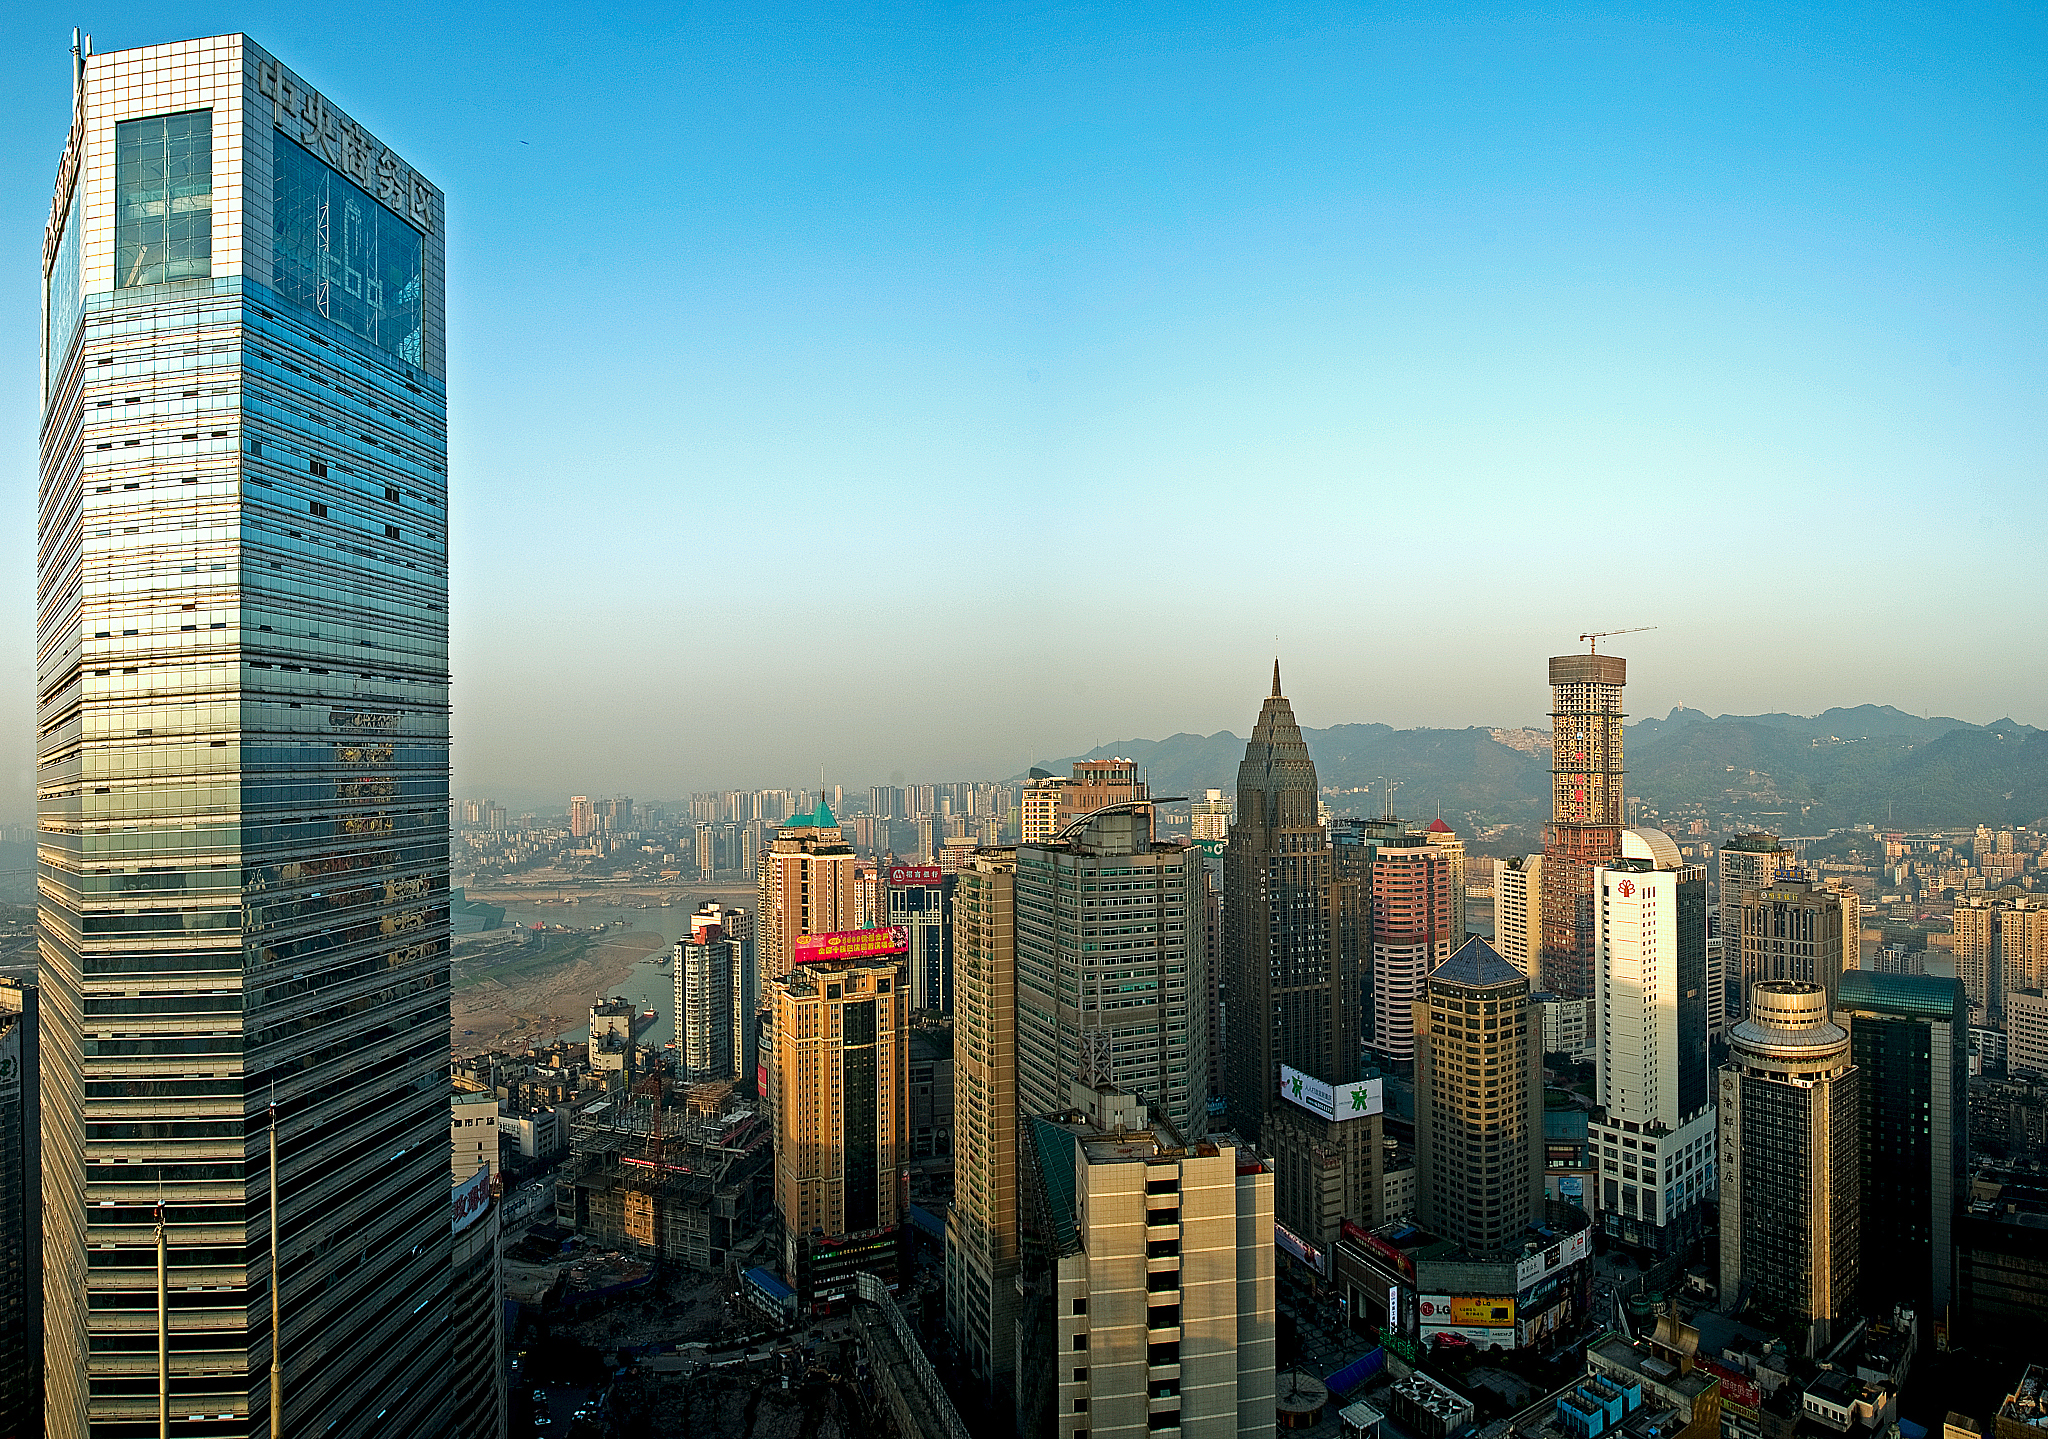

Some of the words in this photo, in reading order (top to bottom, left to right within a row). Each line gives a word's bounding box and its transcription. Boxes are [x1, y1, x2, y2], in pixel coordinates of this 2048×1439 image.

[259, 60, 435, 235] 中央商务区
[1559, 716, 1568, 818] 联合国际
[1594, 716, 1604, 816] 联合国际
[1723, 1096, 1734, 1184] 渝都大酒店
[1436, 1304, 1451, 1315] LG
